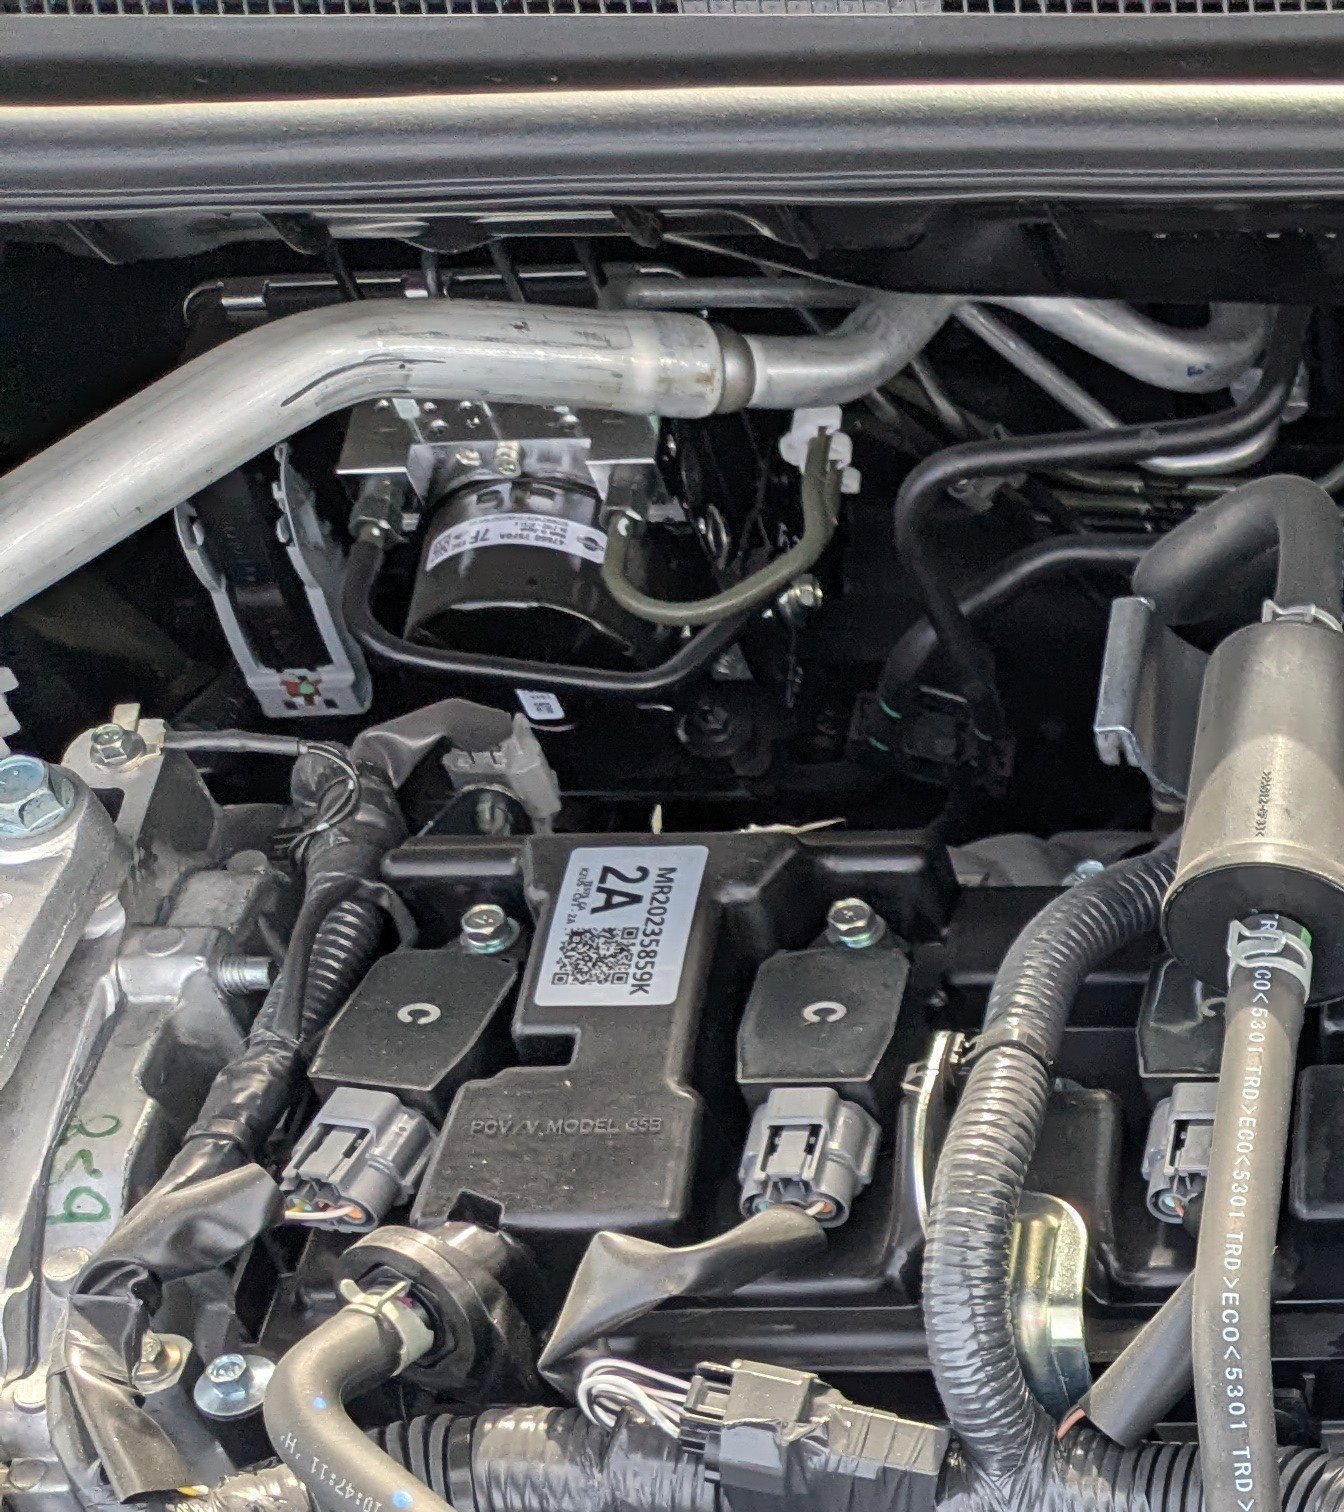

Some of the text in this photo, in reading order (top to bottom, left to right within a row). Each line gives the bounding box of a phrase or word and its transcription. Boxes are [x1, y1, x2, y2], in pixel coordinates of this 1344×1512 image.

[590, 866, 650, 915] 2A
[629, 867, 678, 996] MR20235859K
[547, 1118, 619, 1134] MODEL
